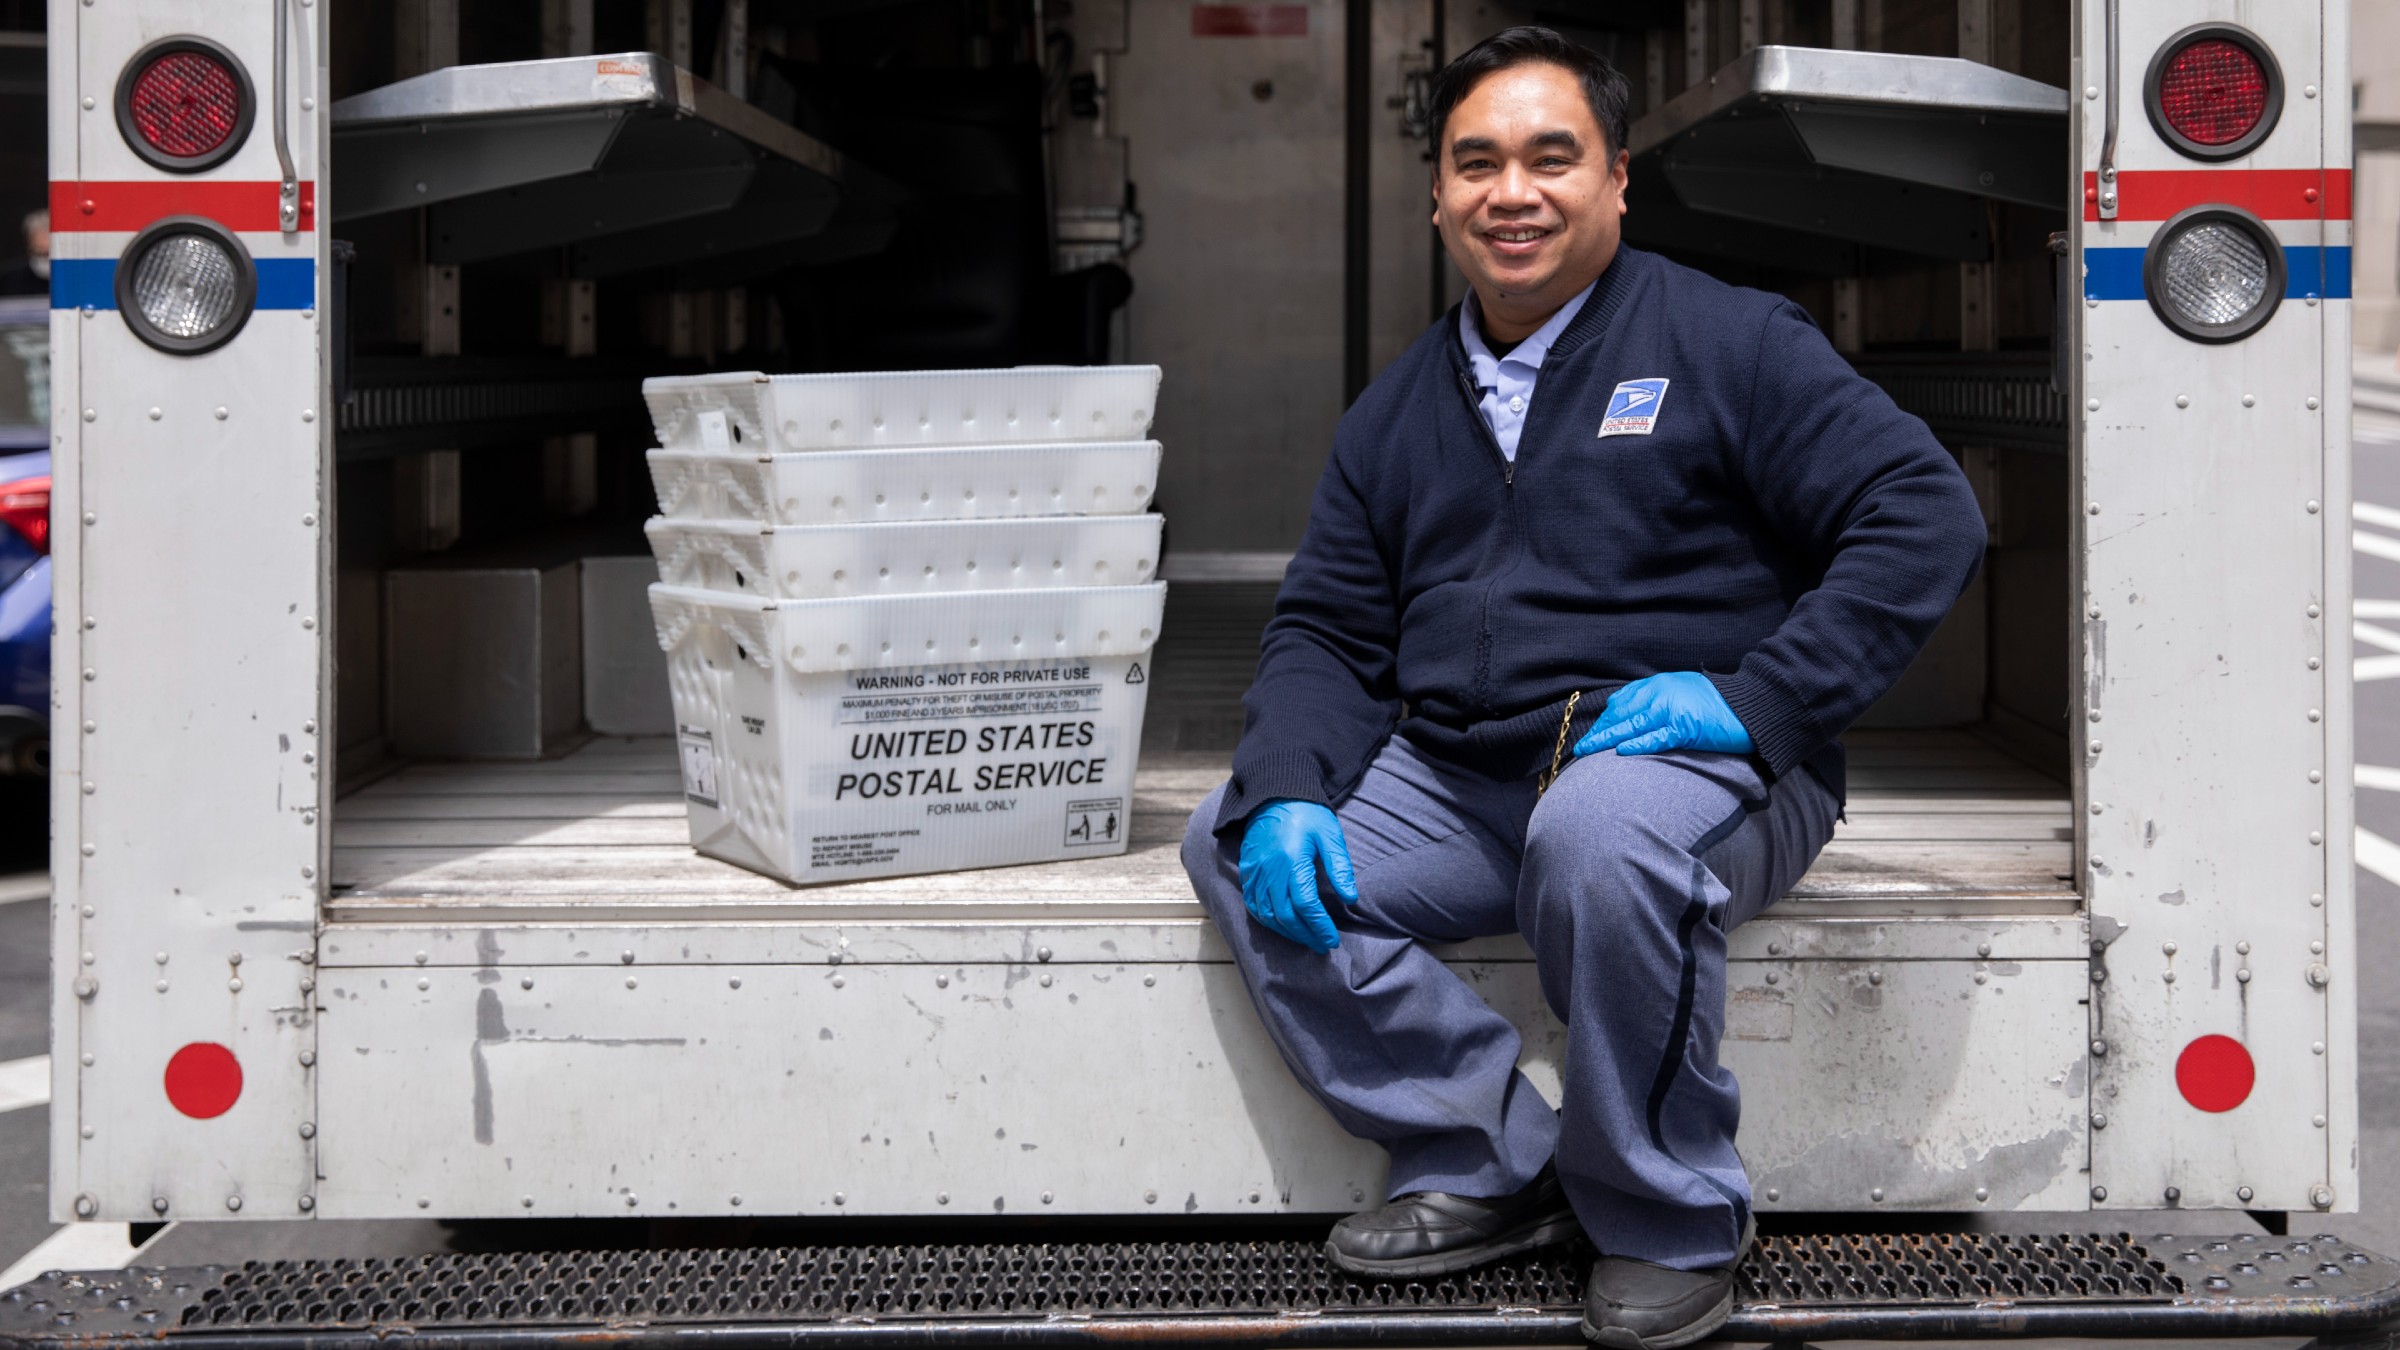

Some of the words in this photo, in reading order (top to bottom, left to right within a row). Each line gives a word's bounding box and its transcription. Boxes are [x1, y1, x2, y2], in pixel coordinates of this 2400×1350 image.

[856, 674, 925, 690] WARNING
[937, 672, 967, 687] NOT
[970, 671, 999, 685] FOR
[1003, 668, 1059, 683] PRIVATE
[1063, 667, 1090, 681] USE
[842, 698, 884, 709] MAXIMUM
[884, 697, 922, 707] PENALTY
[923, 696, 941, 705] FOR
[942, 694, 968, 704] THEFT
[969, 693, 982, 703] OR
[983, 691, 1014, 701] MISUSE
[1015, 690, 1027, 700] OF
[1027, 689, 1058, 700] POSTAL
[1058, 687, 1102, 698] PROPERTY
[865, 708, 890, 720] $1,000
[891, 708, 910, 718] FINE
[910, 707, 930, 718] AND
[936, 705, 964, 716] YEARS
[966, 702, 1027, 714] IMPRISONMENT
[850, 729, 967, 760] UNITED
[976, 721, 1095, 753] STATES
[835, 767, 963, 801] POSTAL
[973, 757, 1107, 792] SERVICE
[926, 803, 952, 816] FOR
[954, 801, 982, 815] MAIL
[984, 799, 1017, 813] ONLY
[898, 829, 920, 837] OFFICE
